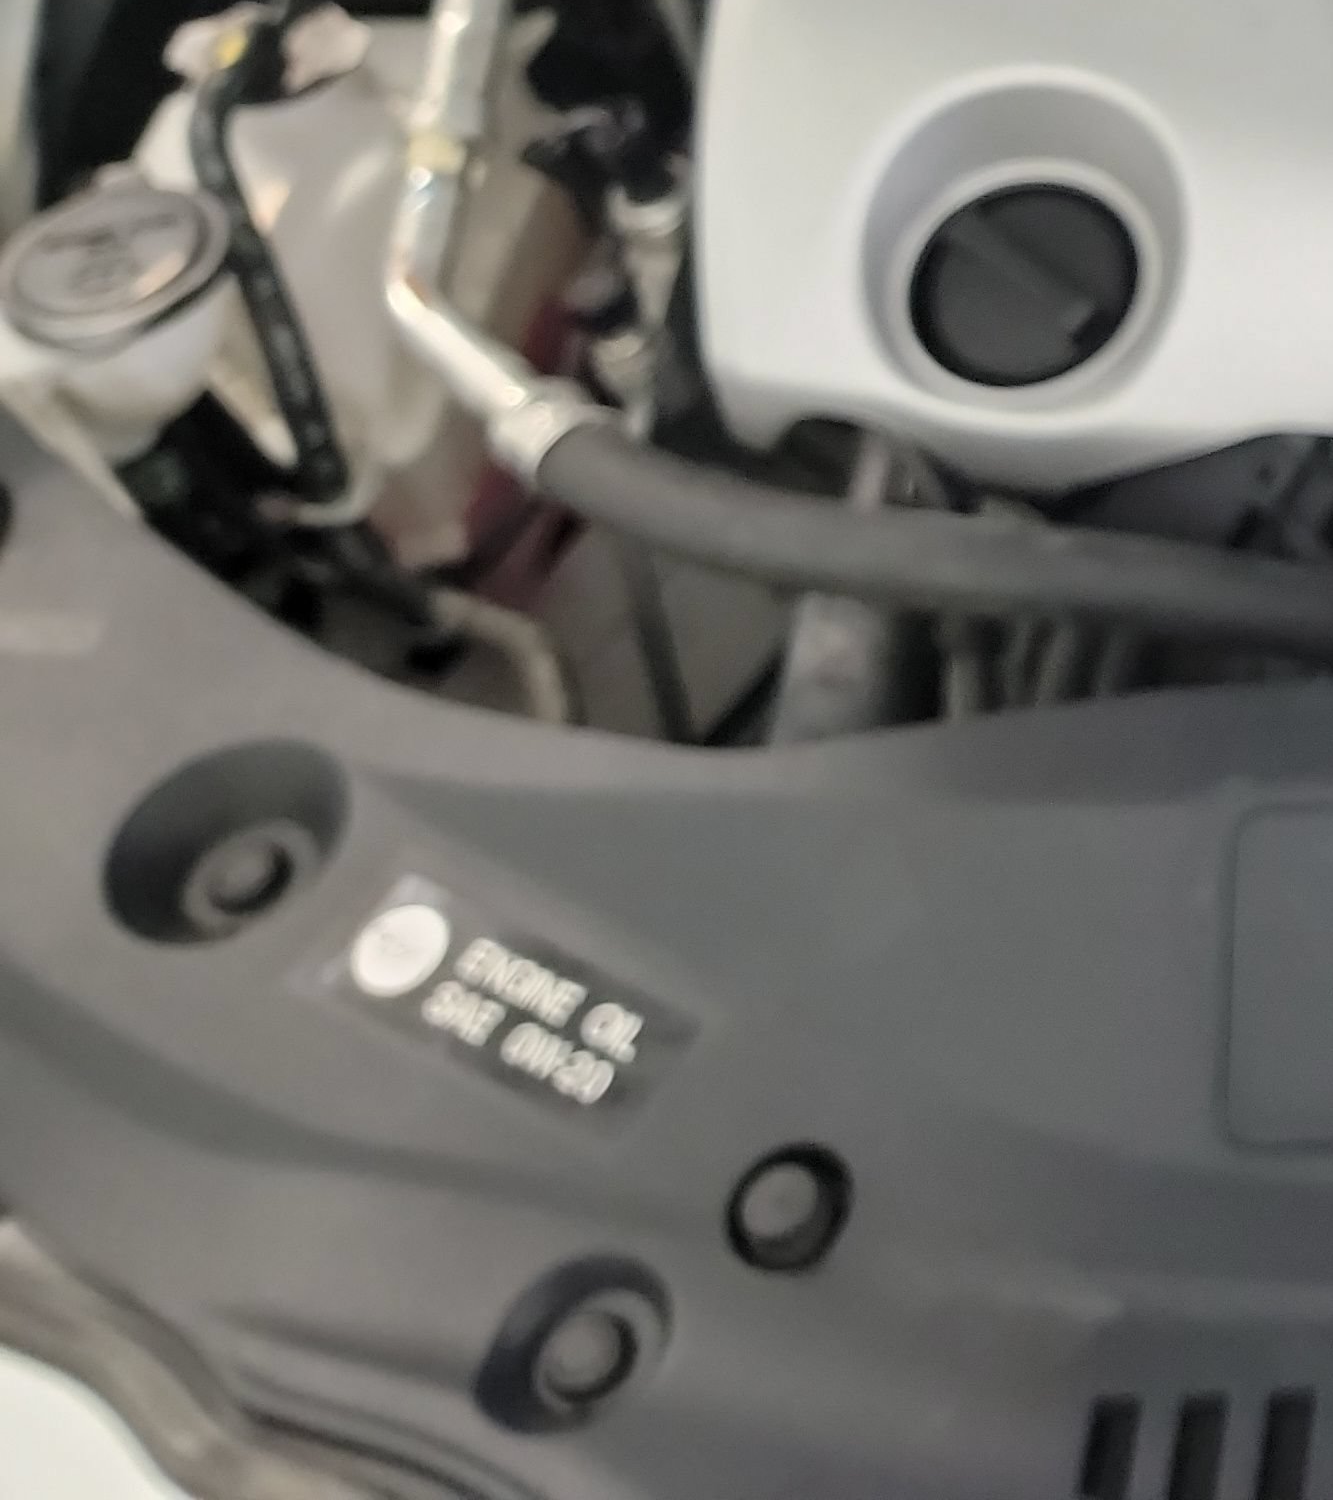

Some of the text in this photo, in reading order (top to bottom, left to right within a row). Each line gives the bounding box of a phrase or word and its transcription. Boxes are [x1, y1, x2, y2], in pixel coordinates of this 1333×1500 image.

[421, 980, 507, 1046] SAE
[455, 938, 643, 1062] ENGINE OIL
